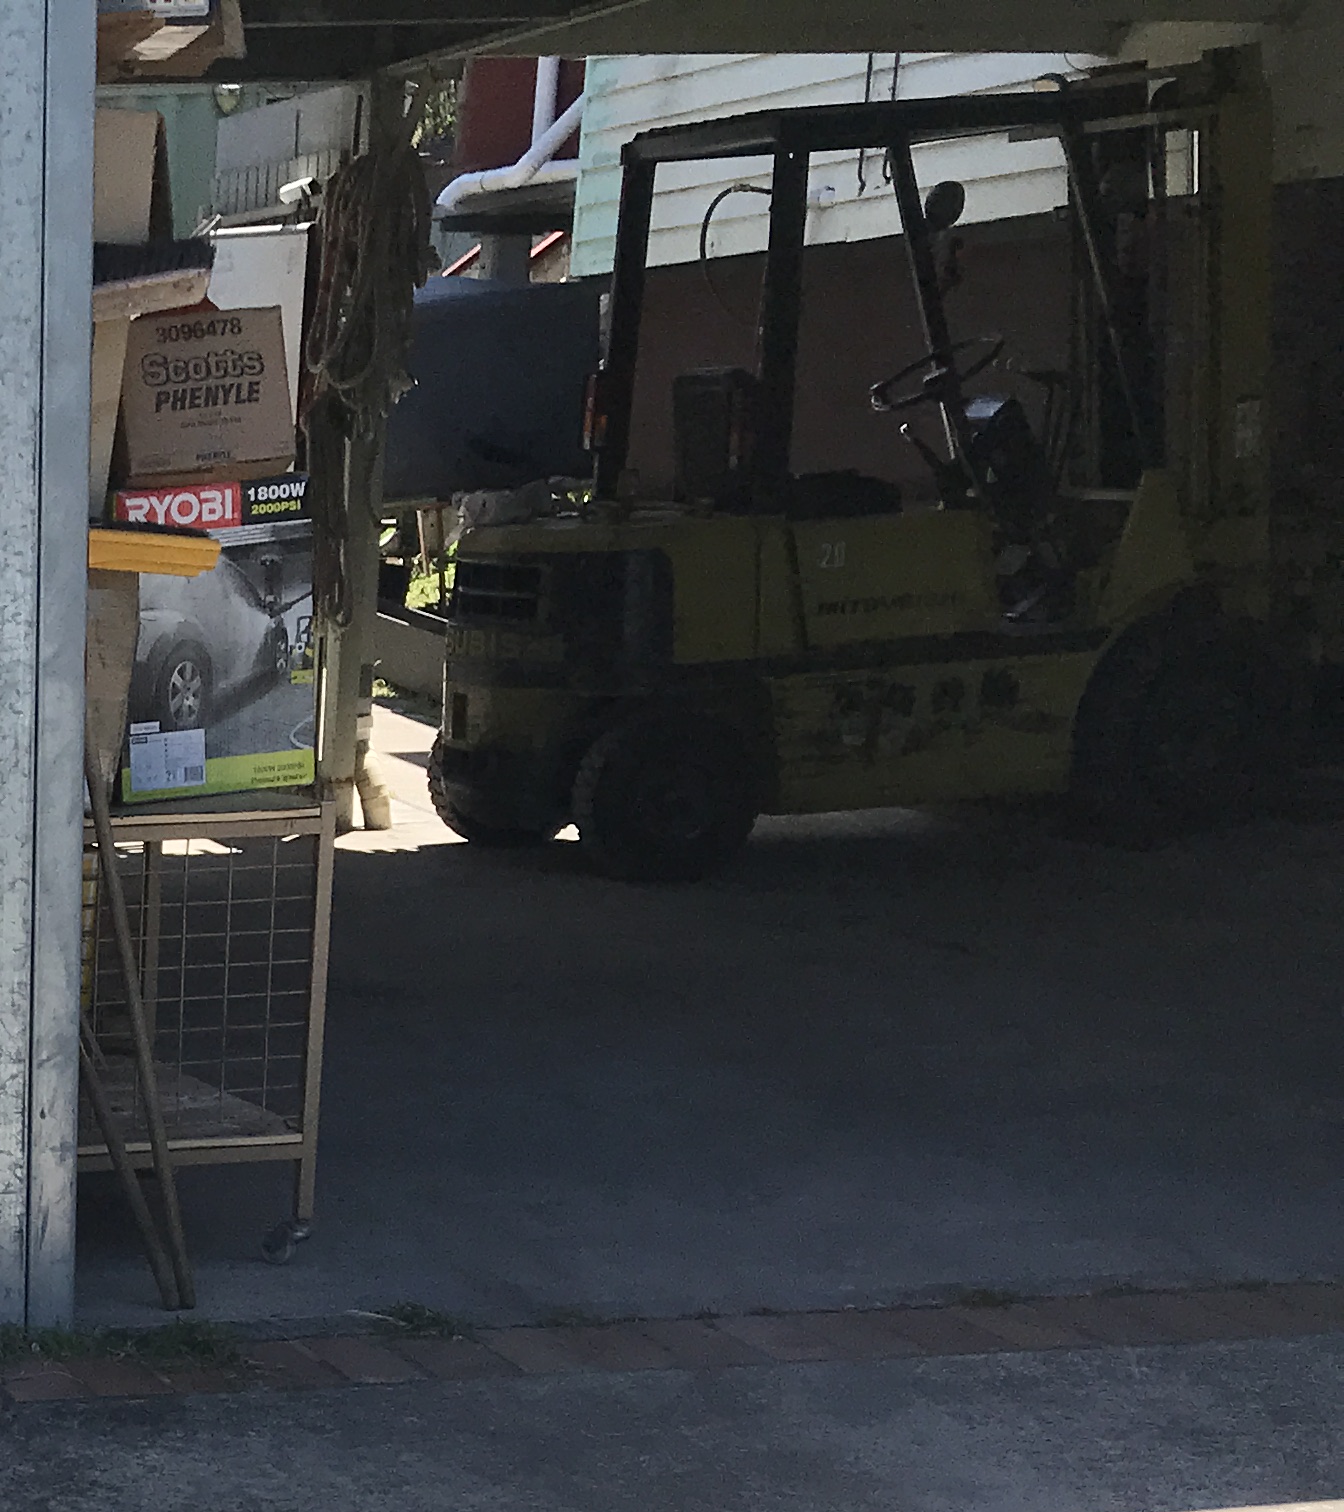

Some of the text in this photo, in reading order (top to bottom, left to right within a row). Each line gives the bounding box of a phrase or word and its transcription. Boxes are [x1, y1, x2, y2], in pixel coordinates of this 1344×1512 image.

[156, 317, 242, 343] 3096478
[141, 350, 264, 386] Scotts
[155, 380, 261, 413] PHENYLE
[248, 481, 306, 501] 1800W
[126, 489, 232, 525] RYOBI
[251, 499, 301, 515] 2000PSI
